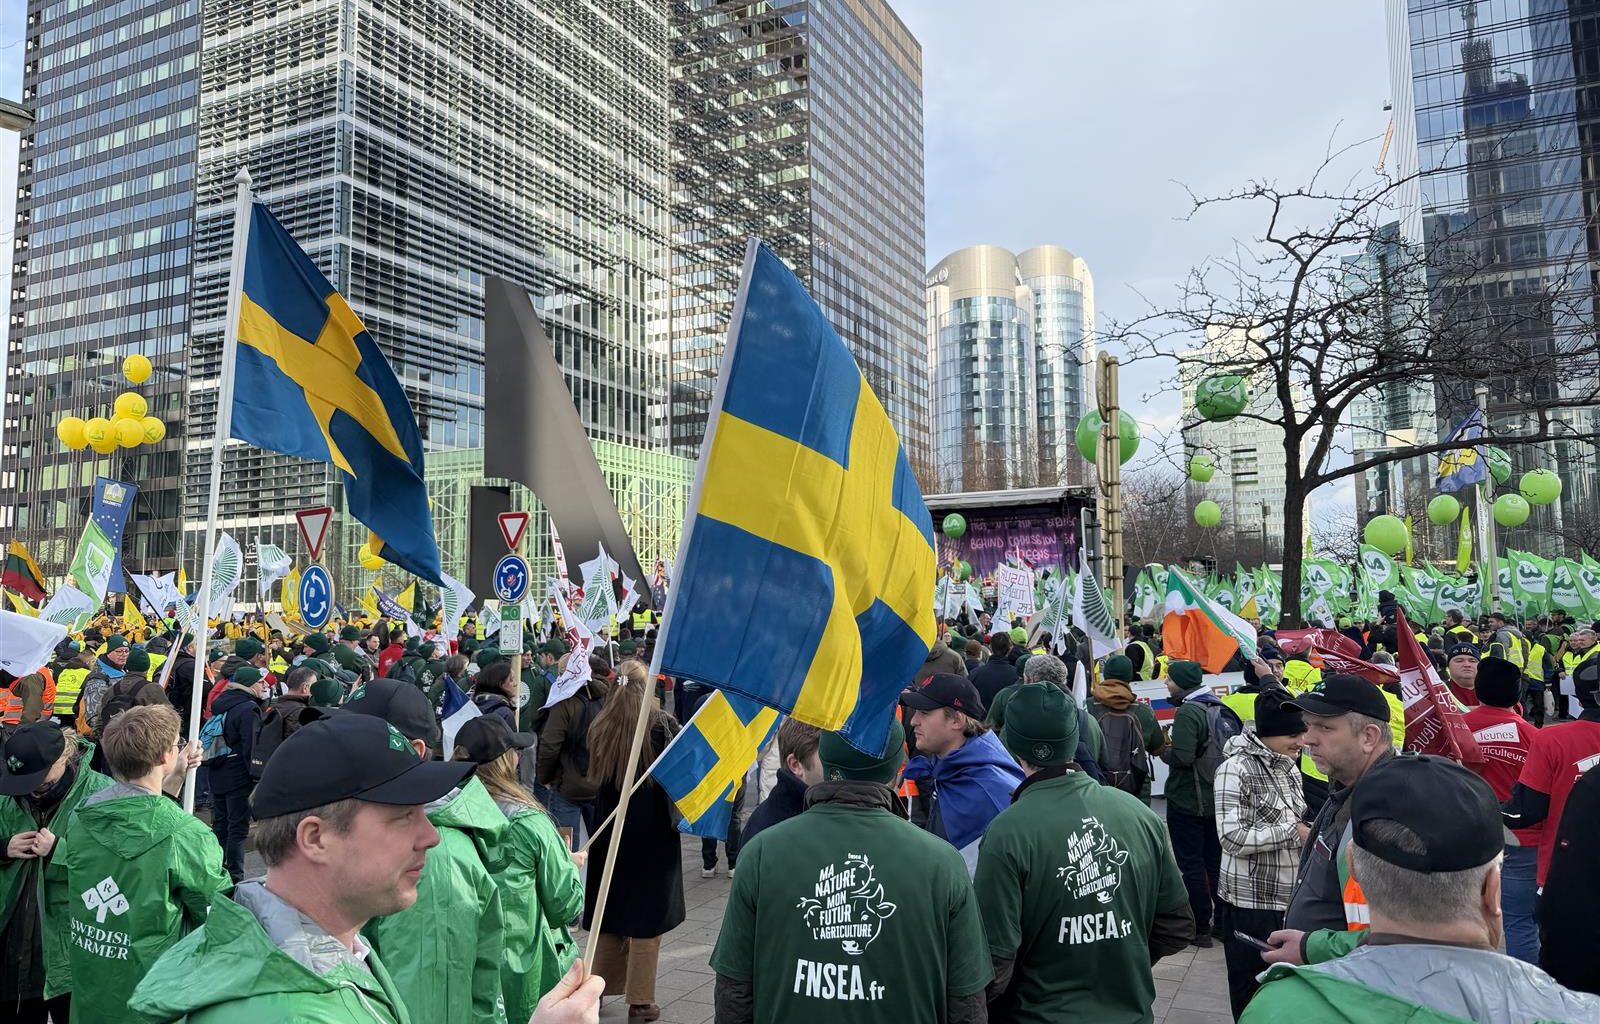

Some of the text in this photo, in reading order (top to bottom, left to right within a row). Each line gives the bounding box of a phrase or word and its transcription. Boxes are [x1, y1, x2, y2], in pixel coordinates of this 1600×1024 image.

[970, 537, 1004, 550] BEHIND
[1478, 731, 1514, 741] Jeunes
[1481, 746, 1527, 763] riculteurs
[1067, 831, 1079, 850] MA
[1067, 829, 1096, 864] NATURE
[1079, 851, 1094, 871] MON
[815, 868, 856, 897] NATURE
[819, 864, 834, 881] MA
[1076, 861, 1100, 887] FUTUR
[1073, 873, 1117, 900] L'AGRICULTURE
[827, 890, 847, 909] MON
[820, 904, 851, 925] FUTUR
[70, 916, 132, 947] SWEDISH
[813, 924, 872, 940] L'AGRICULTURE
[1058, 910, 1132, 945] FNSEA.fr
[70, 931, 129, 961] FARMER
[794, 958, 885, 1001] FNSEA.fr
